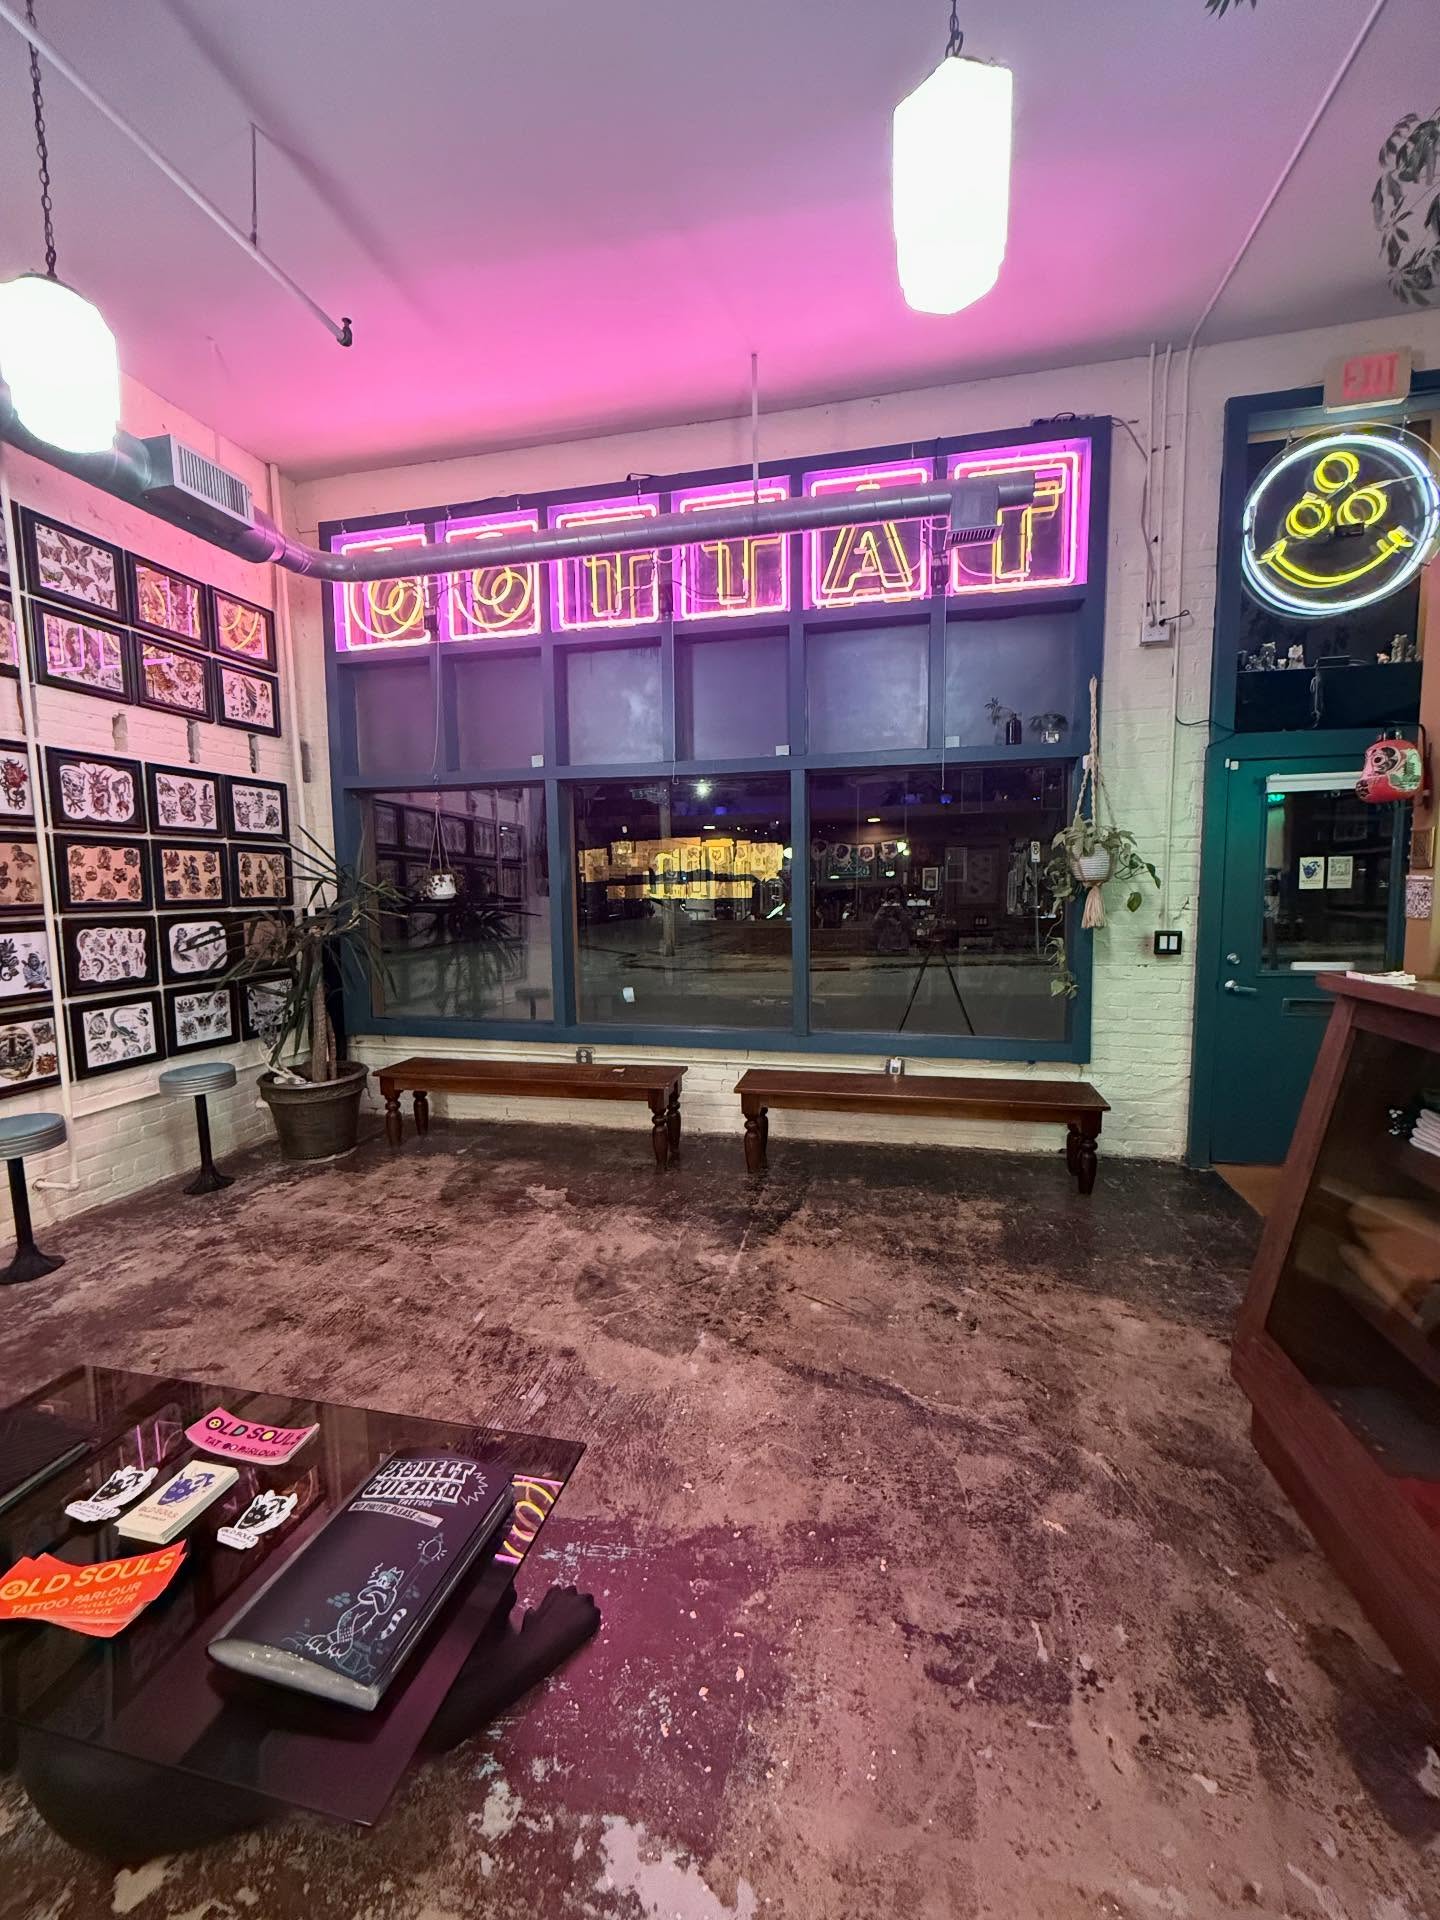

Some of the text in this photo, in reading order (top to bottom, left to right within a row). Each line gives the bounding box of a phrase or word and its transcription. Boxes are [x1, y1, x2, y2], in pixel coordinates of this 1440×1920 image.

[1343, 353, 1398, 398] EXIT
[205, 1416, 249, 1437] OLD
[237, 1446, 280, 1457] PARLOUR
[375, 1460, 478, 1485] PROJECT
[363, 1502, 390, 1513] PHOTOS
[389, 1505, 418, 1519] PLEASE
[398, 1498, 434, 1508] TATTOOS
[0, 1552, 177, 1600] OLD SOULS
[10, 1581, 142, 1615] TATTOO PARLOUR
